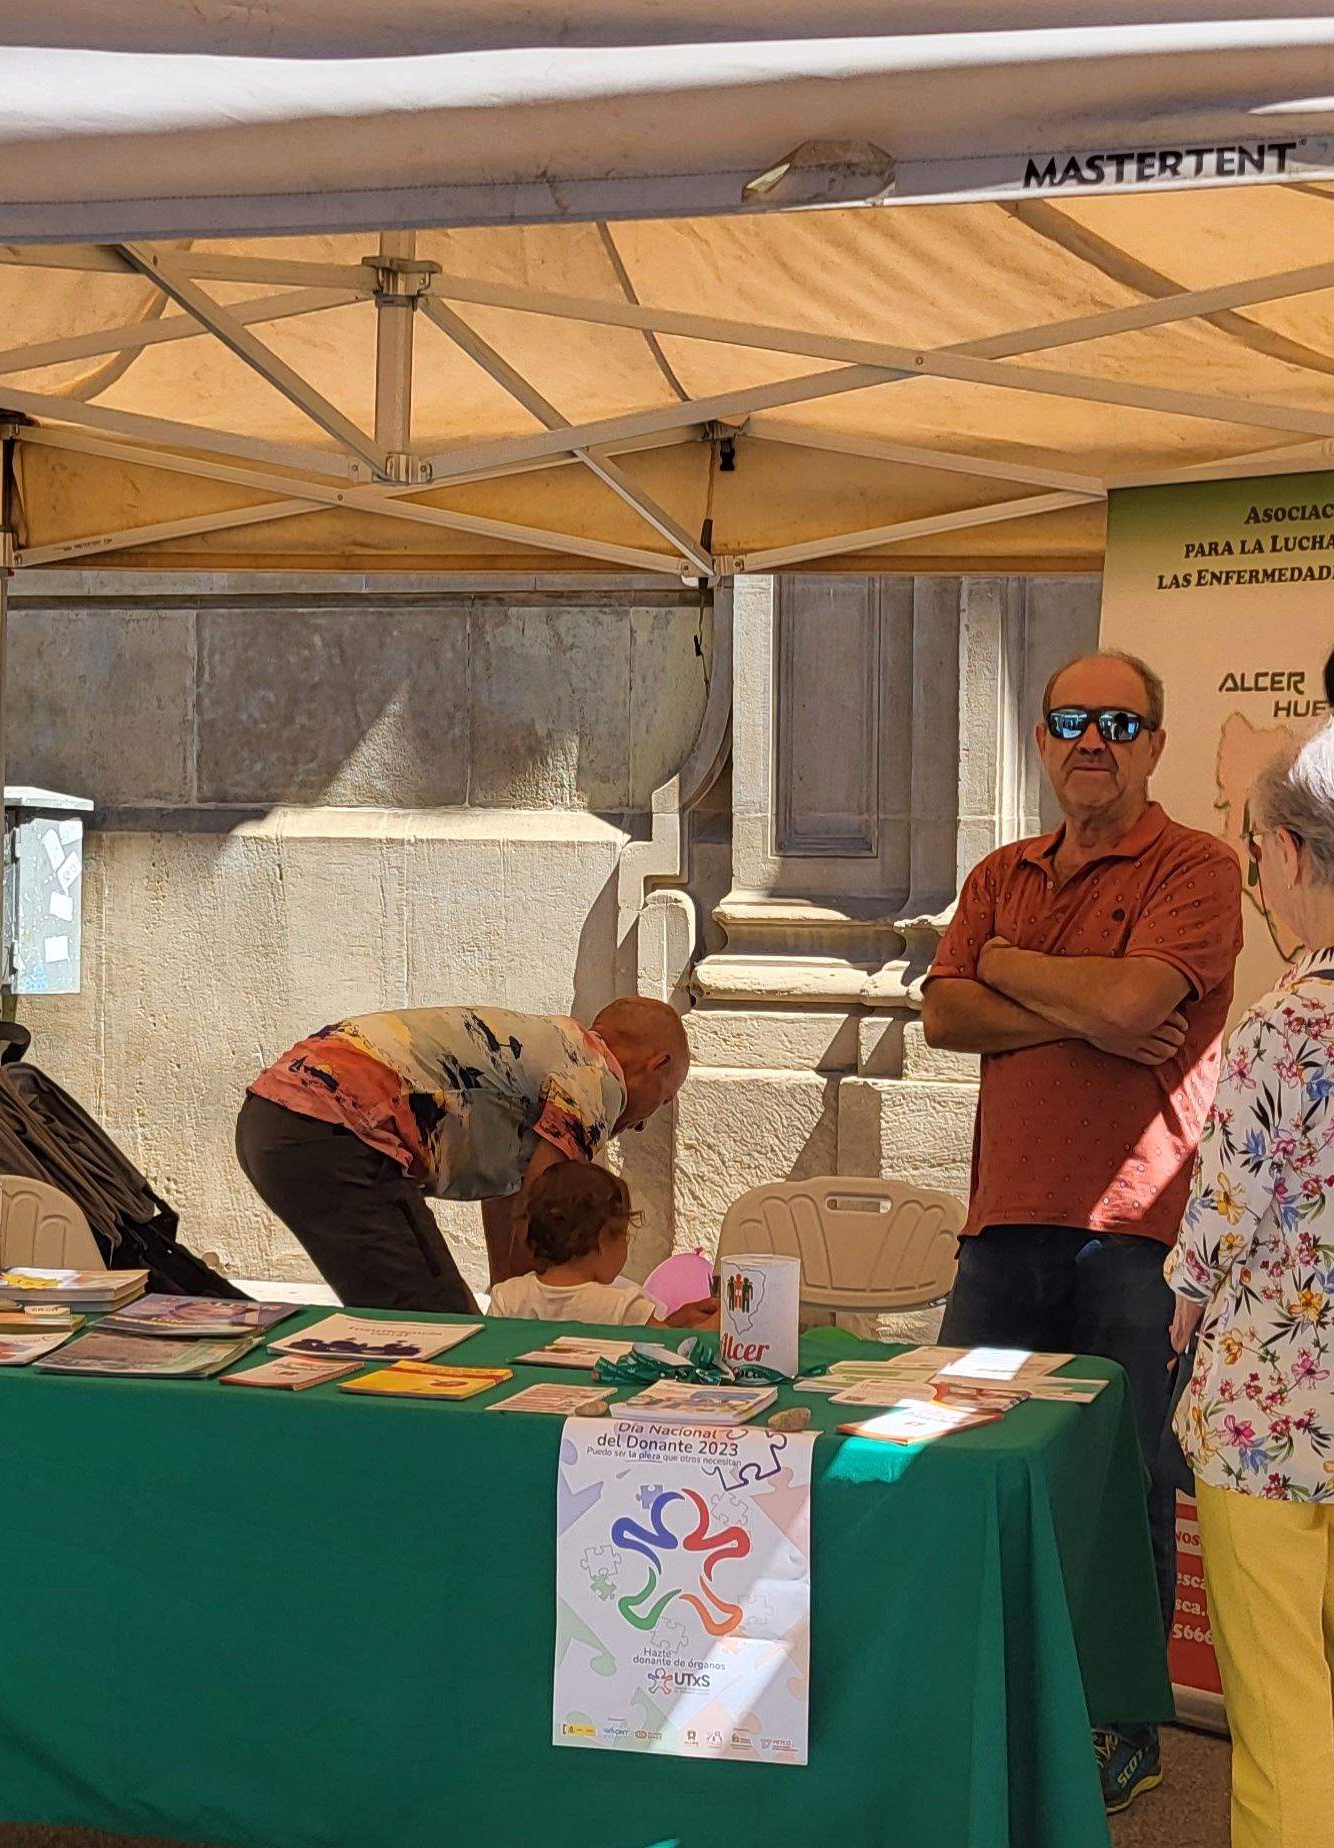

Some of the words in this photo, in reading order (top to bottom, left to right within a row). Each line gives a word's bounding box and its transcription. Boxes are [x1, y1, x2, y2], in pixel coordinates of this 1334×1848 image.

[1024, 142, 1297, 188] MASTERTENT
[1184, 541, 1234, 559] PARA
[1239, 539, 1264, 555] LA
[1157, 572, 1192, 590] LAS
[1218, 672, 1305, 695] ALCER
[618, 1421, 644, 1434] Día
[648, 1423, 717, 1440] Nacional
[597, 1433, 621, 1447] del
[626, 1435, 693, 1454] Donante
[698, 1441, 739, 1457] 2023
[586, 1445, 612, 1457] Puedo
[614, 1449, 627, 1458] ser
[629, 1449, 637, 1459] la
[639, 1451, 661, 1463] pieza
[663, 1453, 678, 1464] que
[680, 1455, 701, 1464] otros
[703, 1457, 742, 1467] necesitan
[643, 1647, 672, 1658] Hazte
[632, 1655, 672, 1667] donante
[674, 1658, 686, 1667] de
[688, 1658, 726, 1671] órganos
[674, 1671, 711, 1688] UTxS
[1117, 1746, 1149, 1789] SCOT
